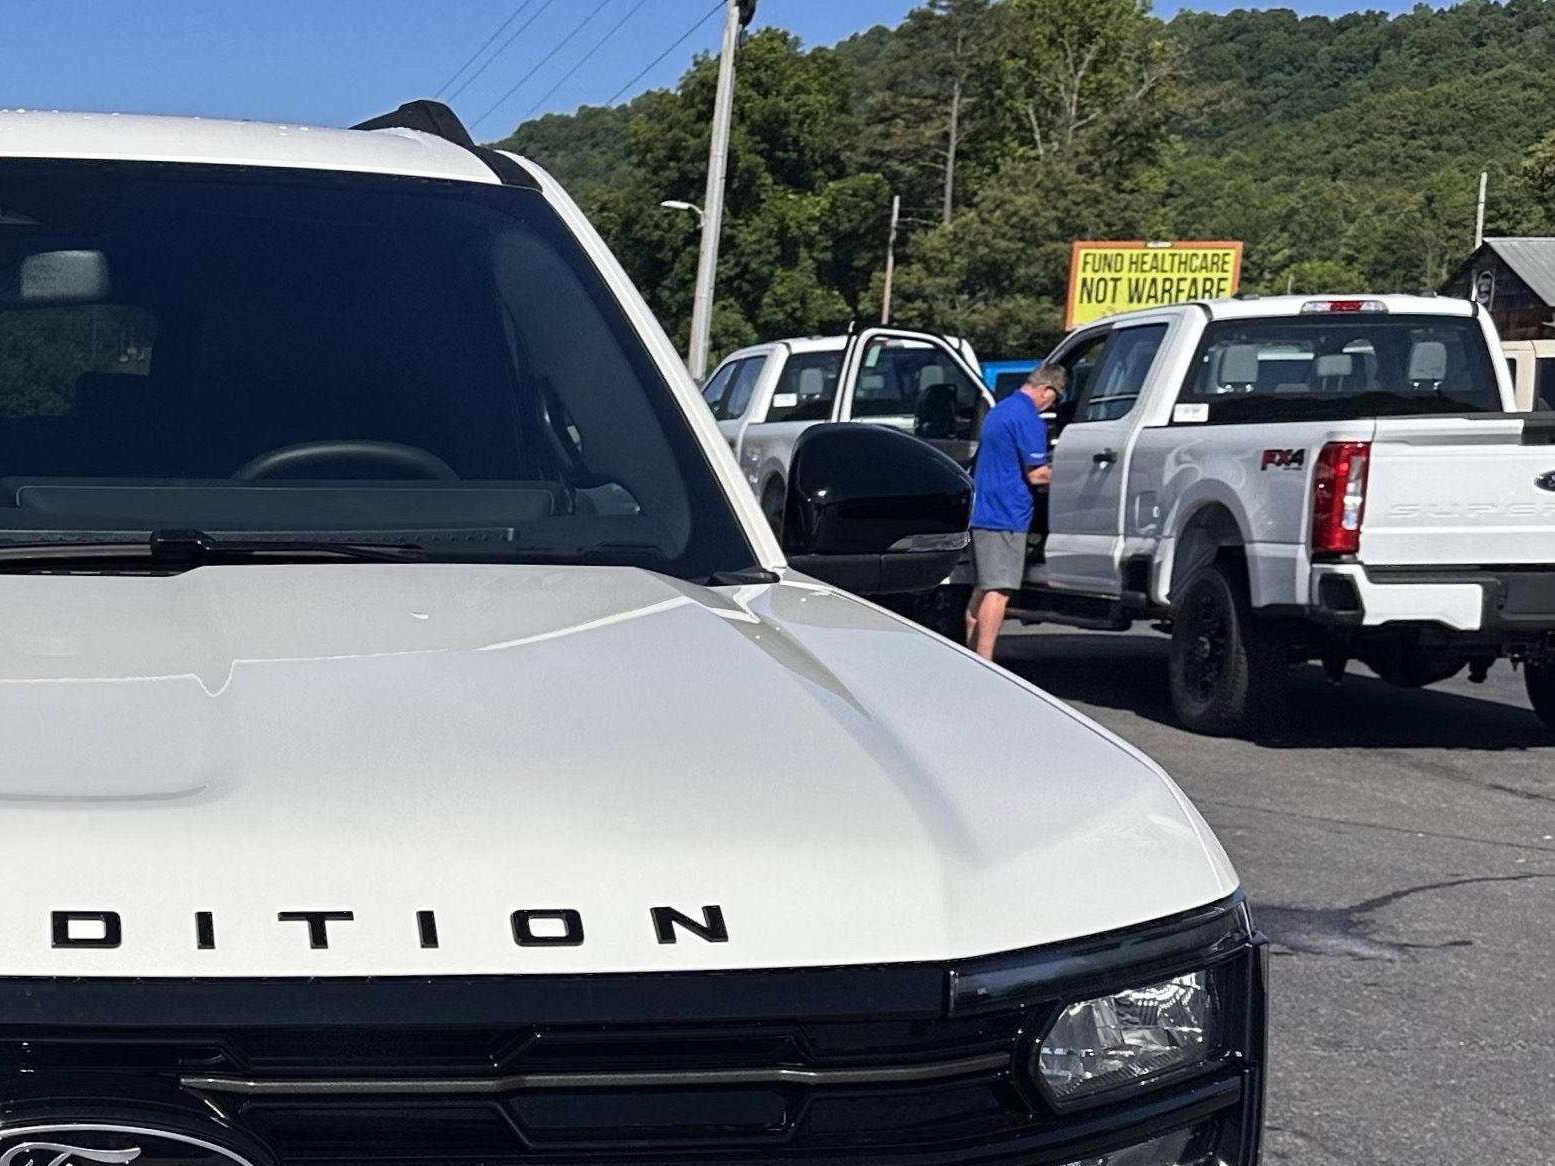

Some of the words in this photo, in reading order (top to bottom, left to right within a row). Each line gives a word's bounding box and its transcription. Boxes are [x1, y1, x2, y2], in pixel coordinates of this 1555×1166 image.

[1082, 252, 1125, 274] FUND
[1128, 252, 1232, 274] HEALTHCARE
[1078, 277, 1122, 305] NOT
[1260, 448, 1305, 471] FX4
